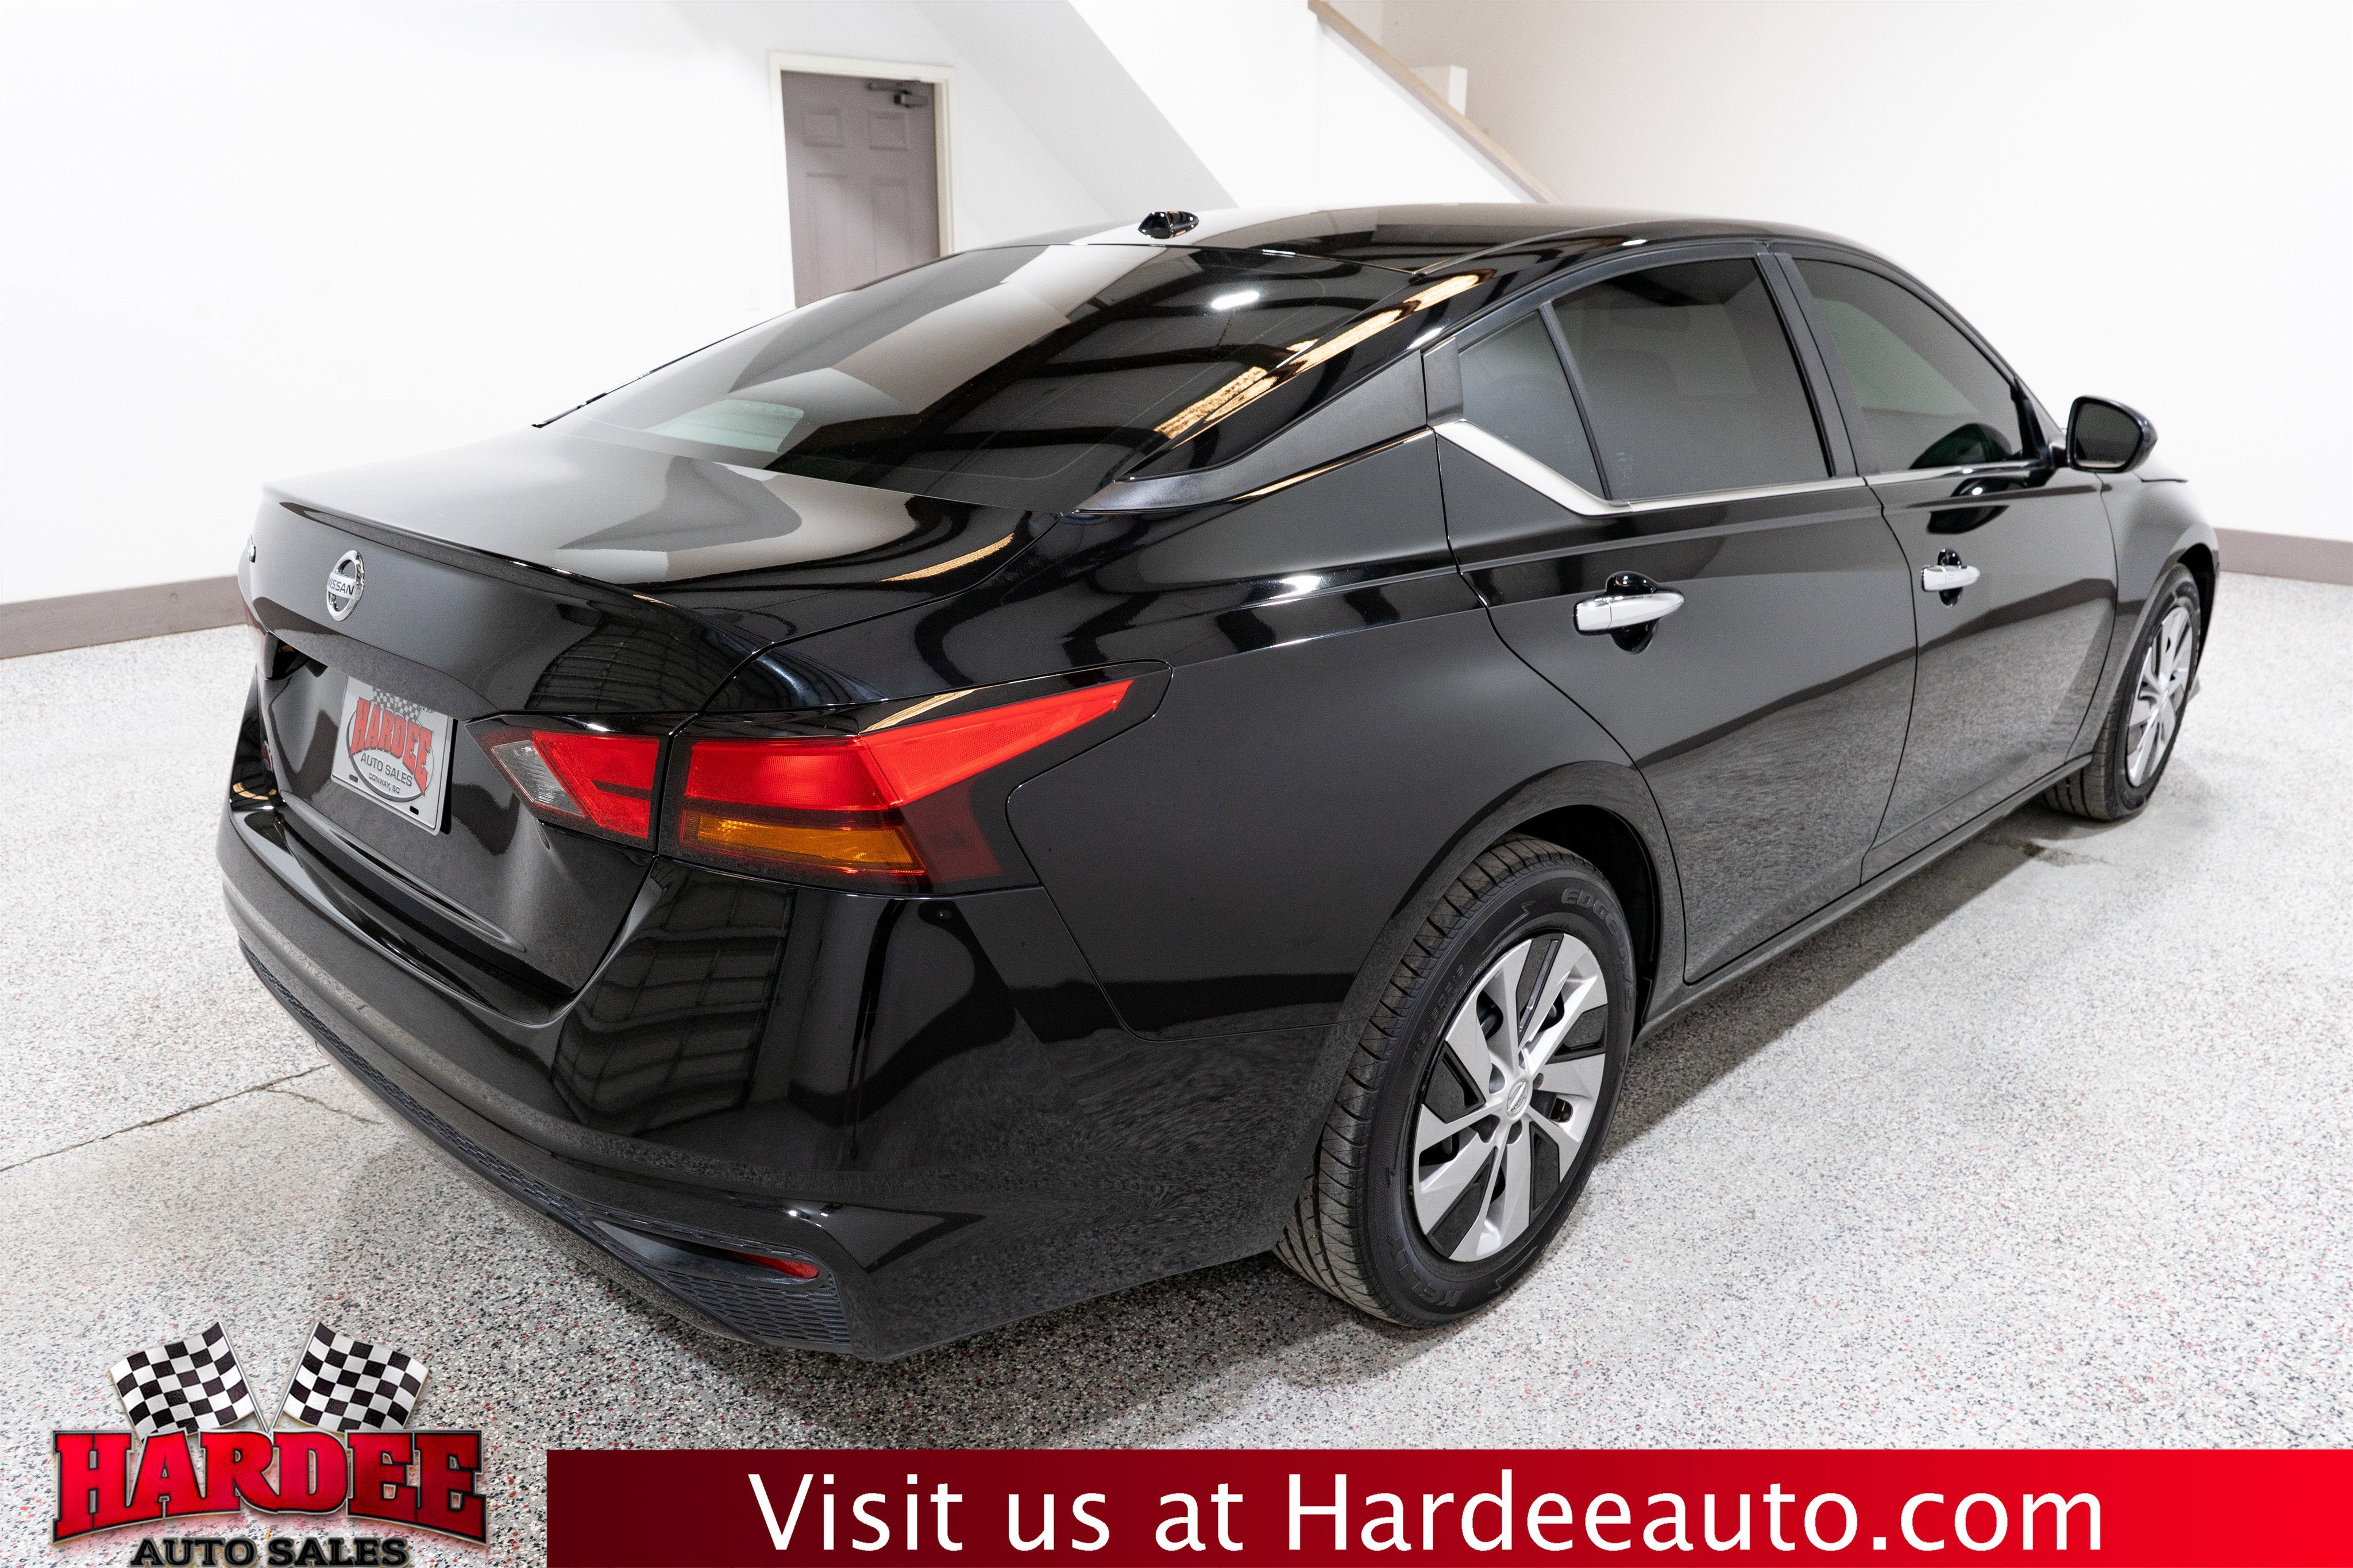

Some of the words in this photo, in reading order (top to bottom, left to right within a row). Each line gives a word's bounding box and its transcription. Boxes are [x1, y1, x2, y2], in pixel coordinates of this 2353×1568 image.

[327, 577, 355, 596] NISSAN
[349, 697, 433, 795] HARDEE
[360, 752, 383, 771] AUTO
[385, 764, 412, 787] SALES
[368, 773, 391, 791] CONWAY,
[392, 785, 400, 794] SC
[1561, 887, 1620, 937] EDGE
[1386, 1233, 1465, 1307] KELLY
